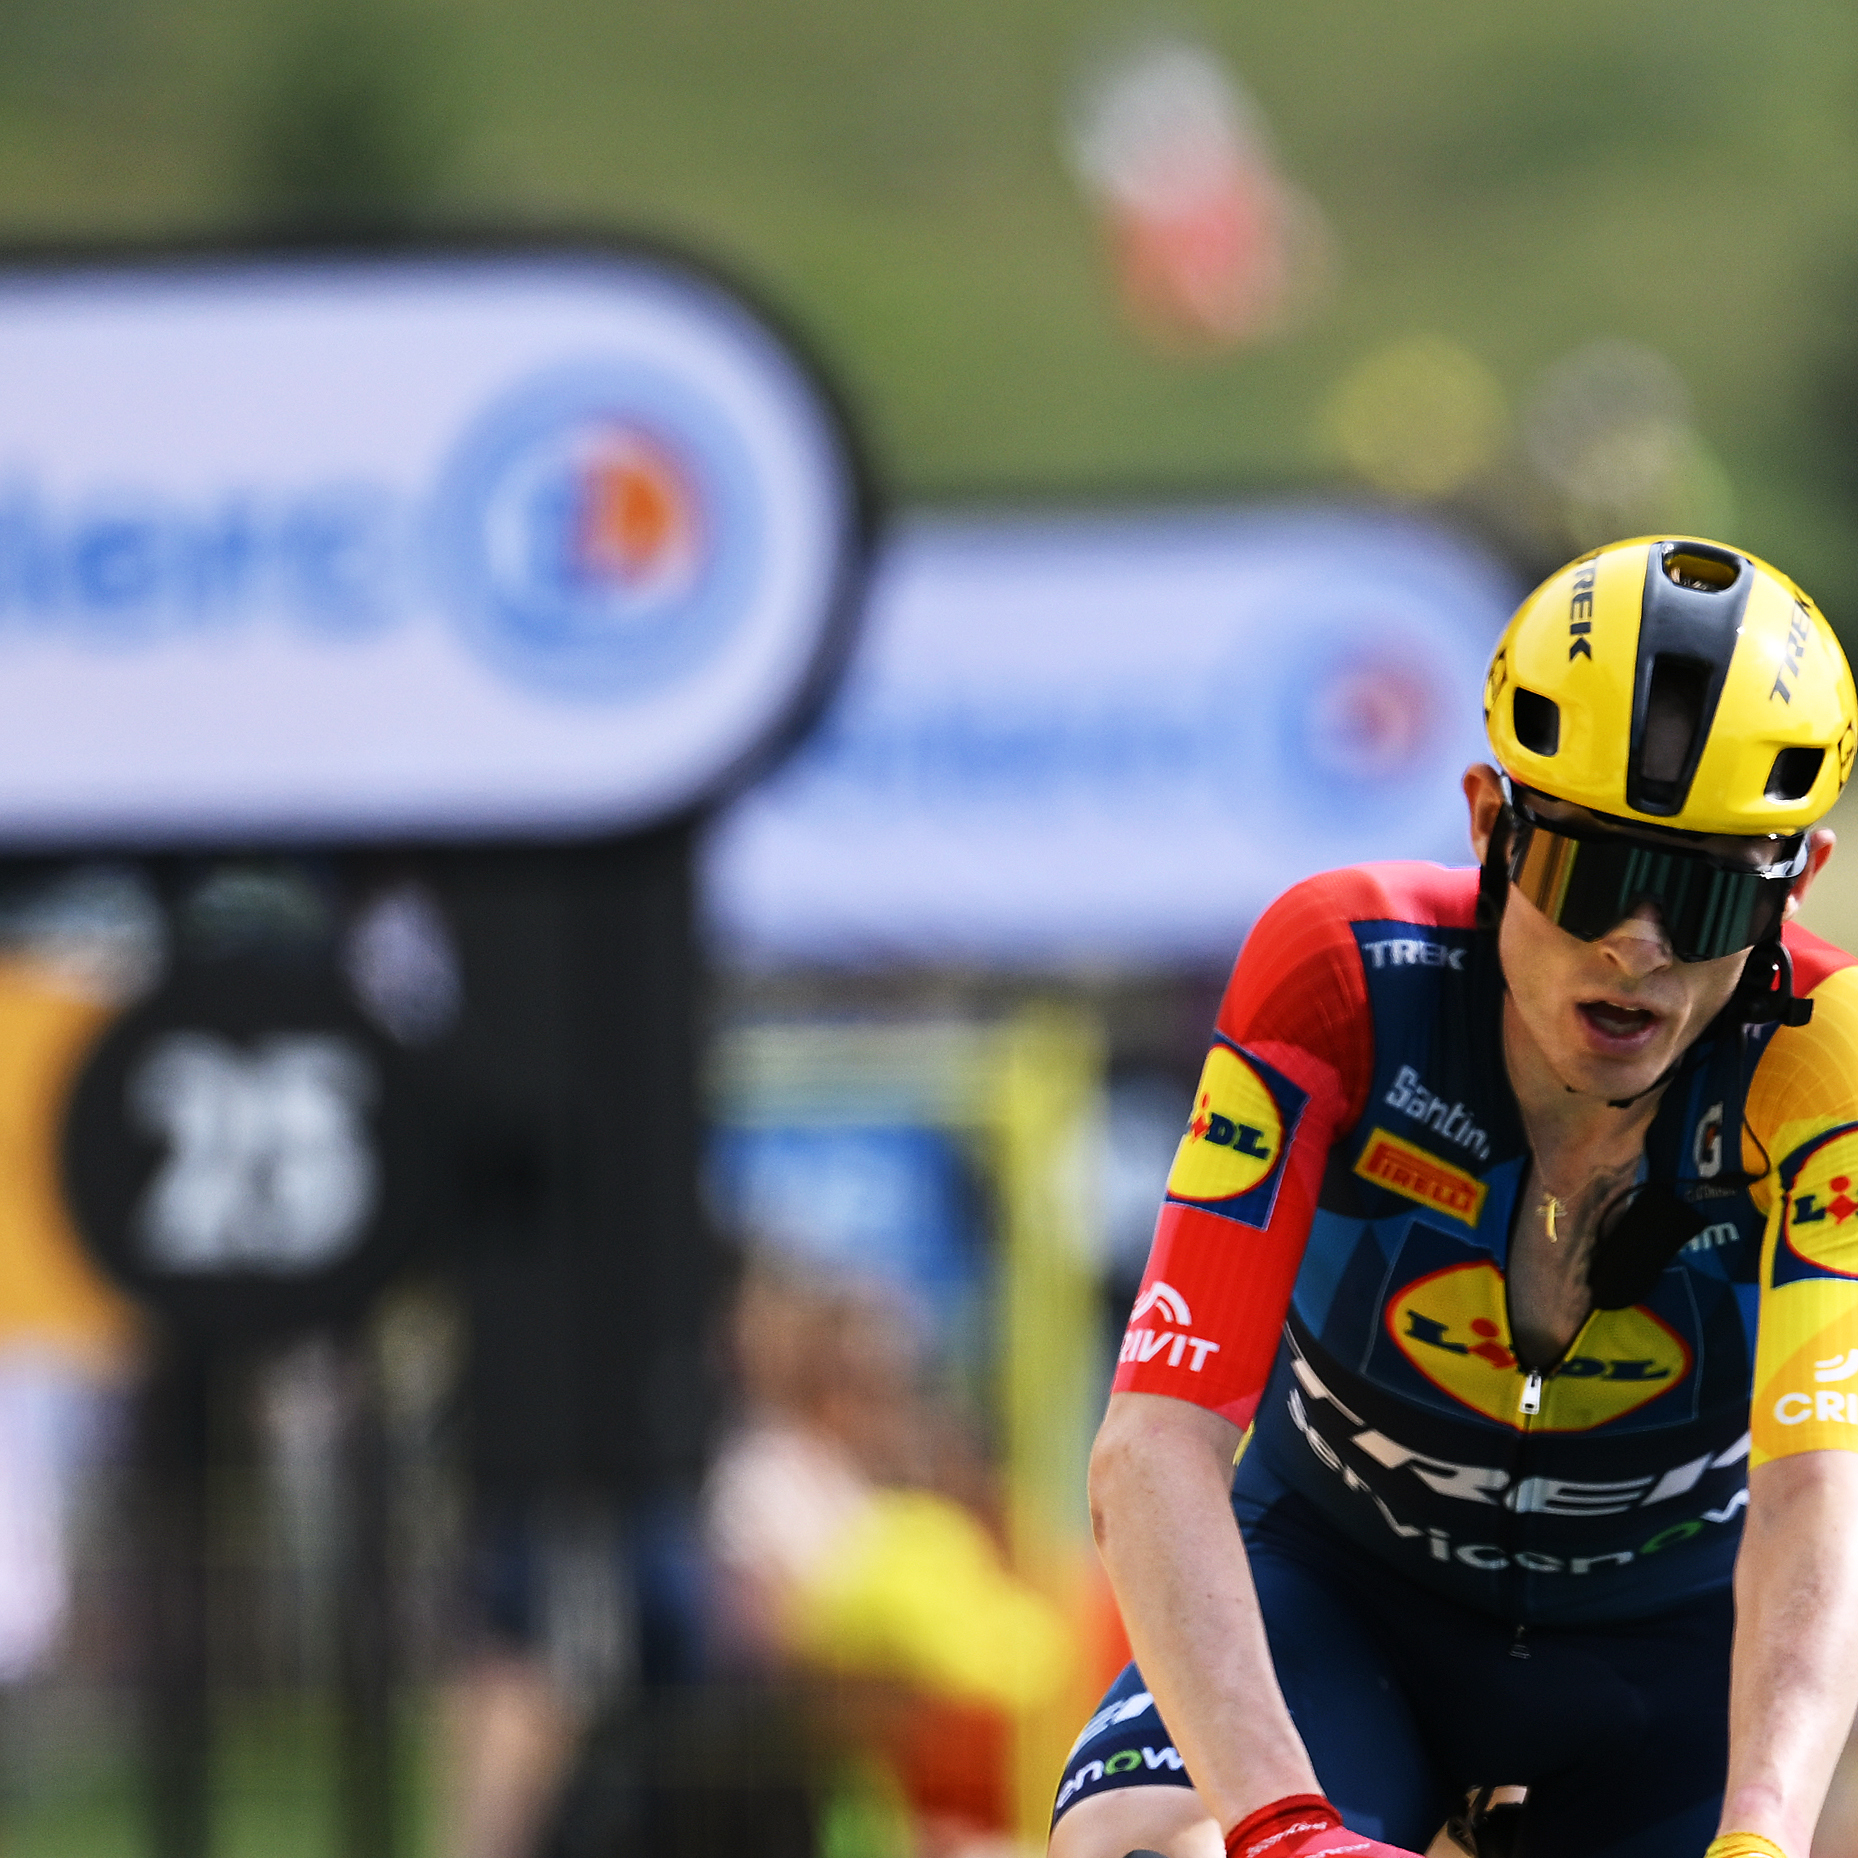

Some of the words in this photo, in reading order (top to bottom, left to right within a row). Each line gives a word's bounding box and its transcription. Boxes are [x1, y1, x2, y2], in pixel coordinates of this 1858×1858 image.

[1569, 558, 1602, 662] REK
[1361, 938, 1467, 971] TREK
[1118, 1327, 1221, 1374] RIVIT
